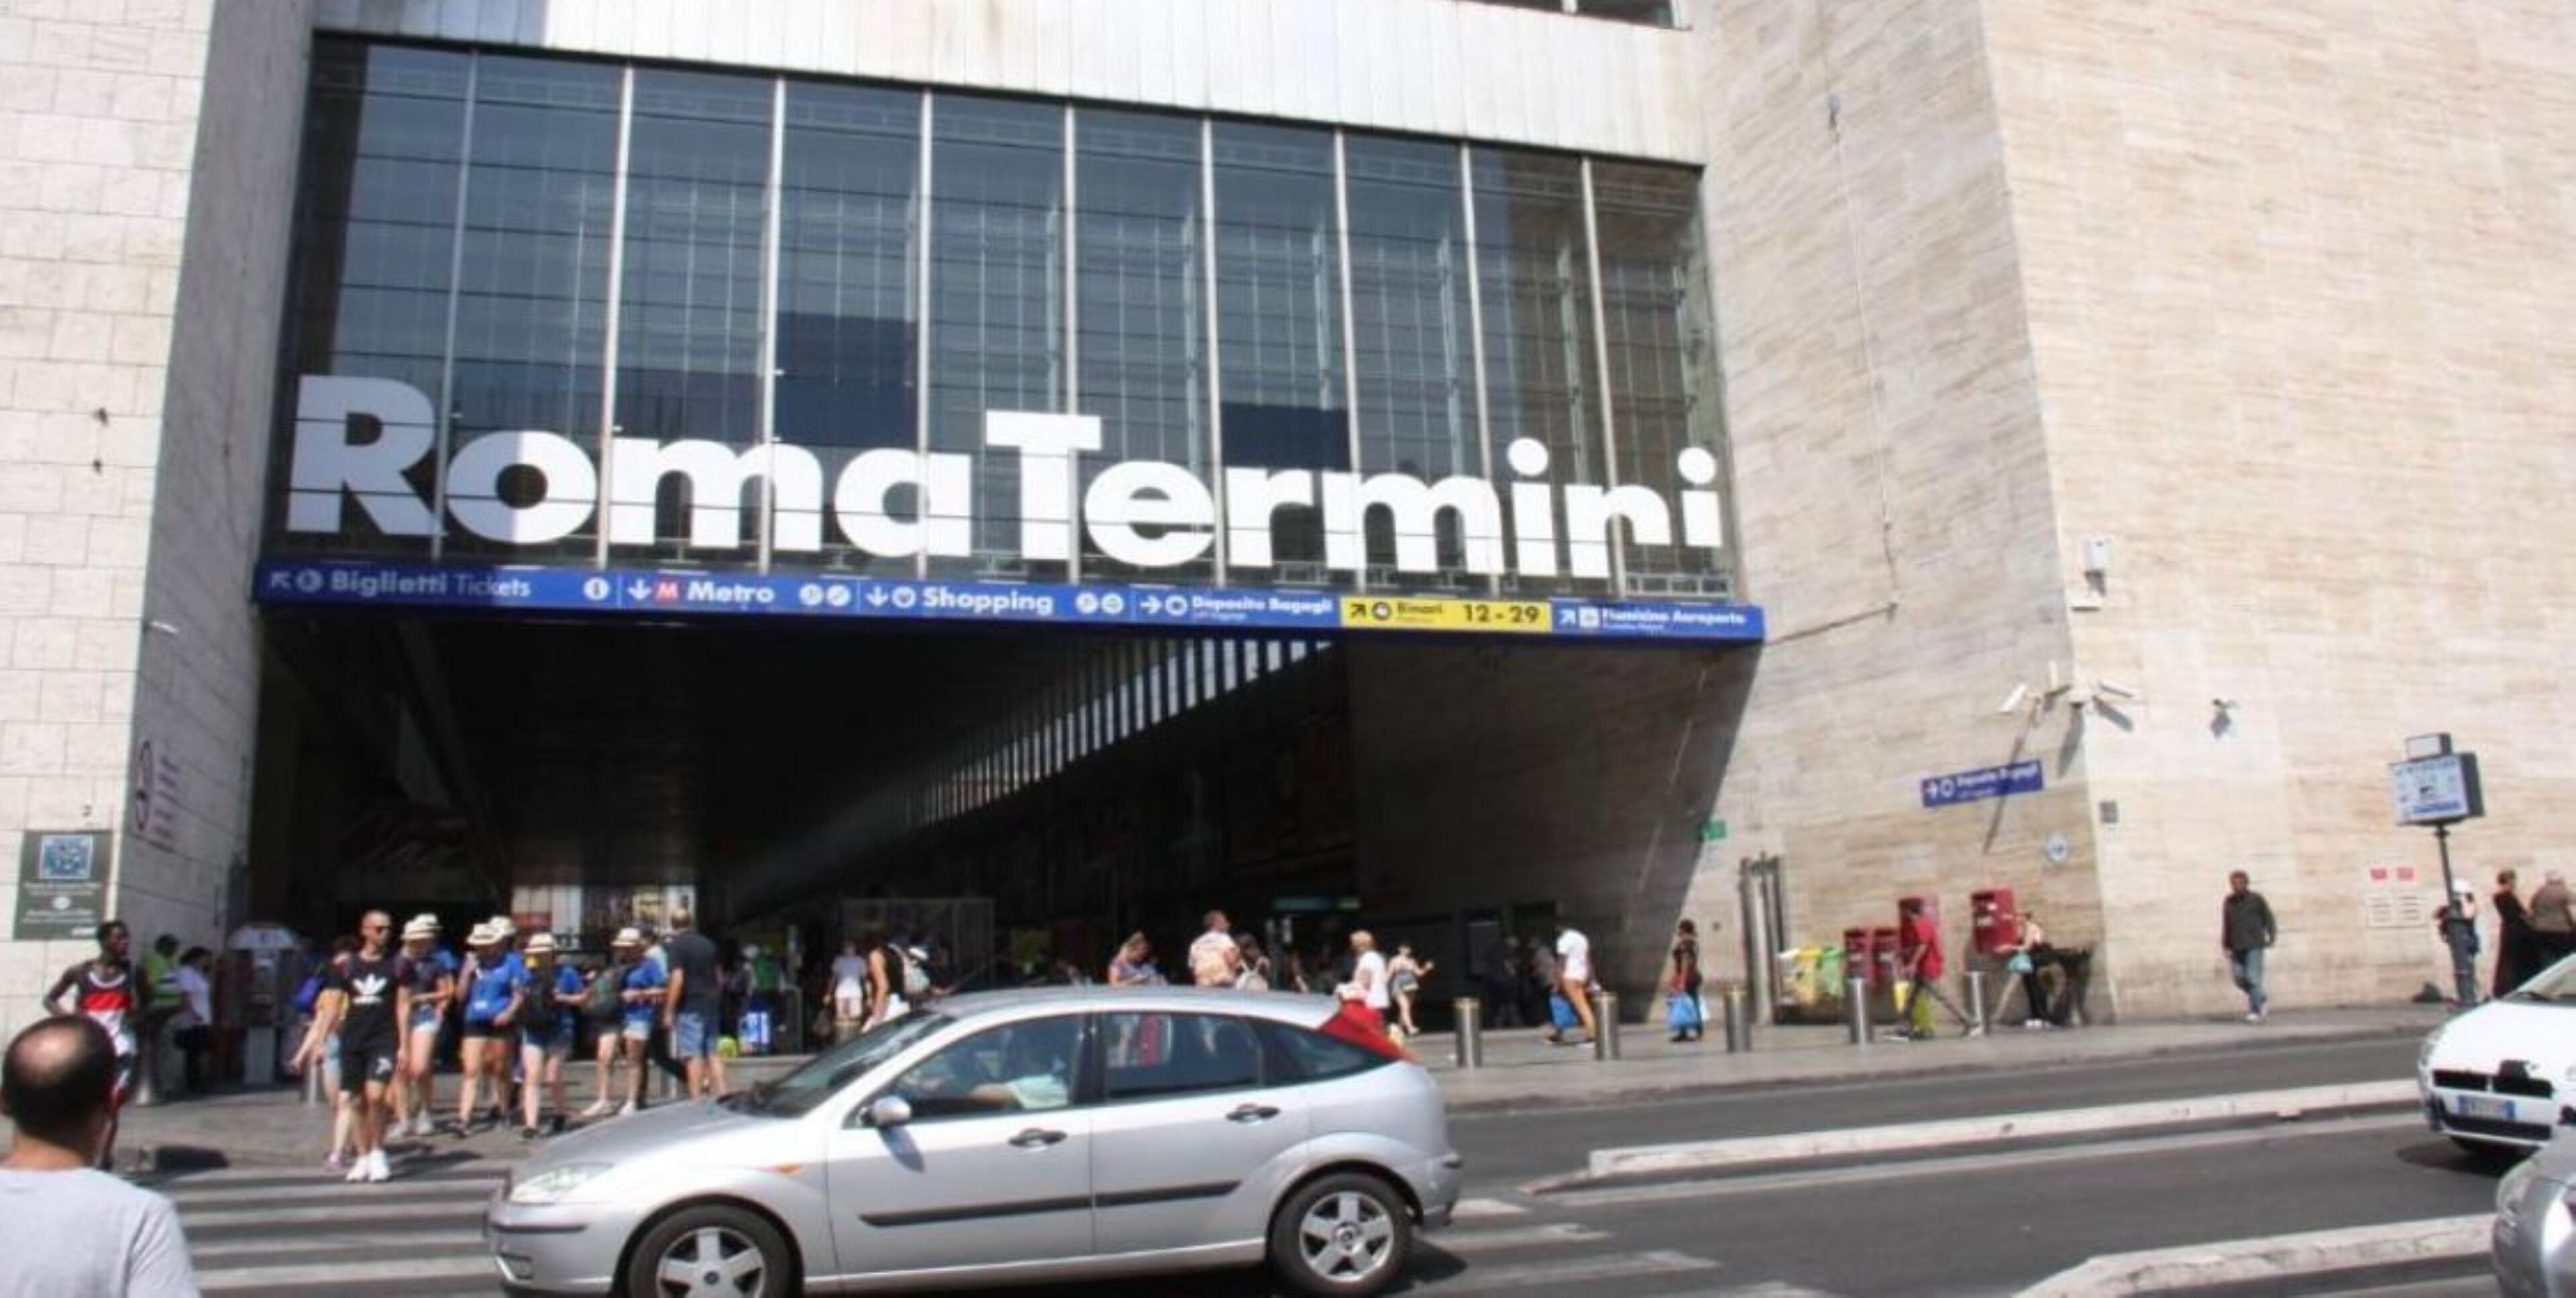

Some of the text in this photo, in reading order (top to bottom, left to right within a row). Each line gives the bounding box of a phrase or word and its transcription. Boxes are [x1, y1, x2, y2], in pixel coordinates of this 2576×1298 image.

[331, 569, 531, 597] Biglietti Tickets
[687, 581, 775, 602] Metro
[923, 586, 1054, 615] Shopping
